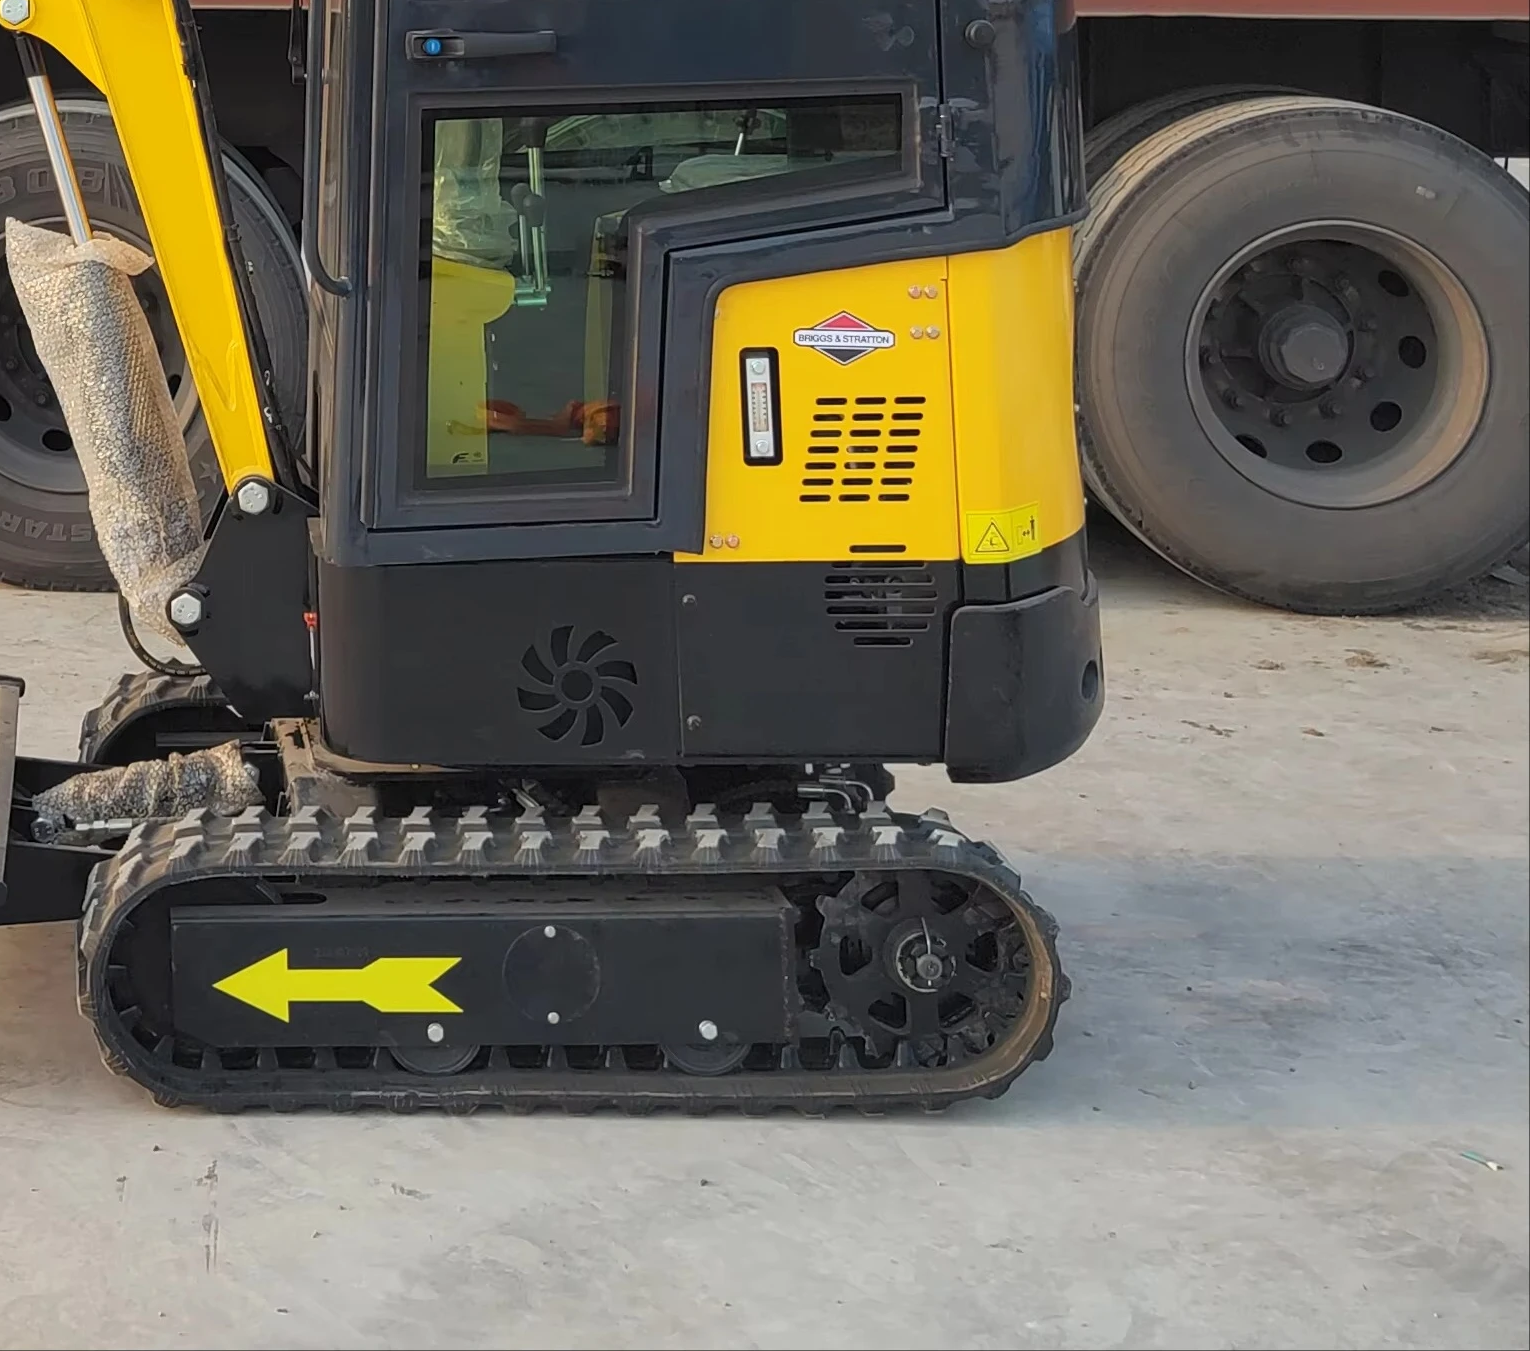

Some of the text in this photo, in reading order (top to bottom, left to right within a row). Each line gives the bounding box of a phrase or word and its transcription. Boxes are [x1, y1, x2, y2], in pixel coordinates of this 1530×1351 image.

[798, 334, 890, 344] BRIGGS & STRATTON
